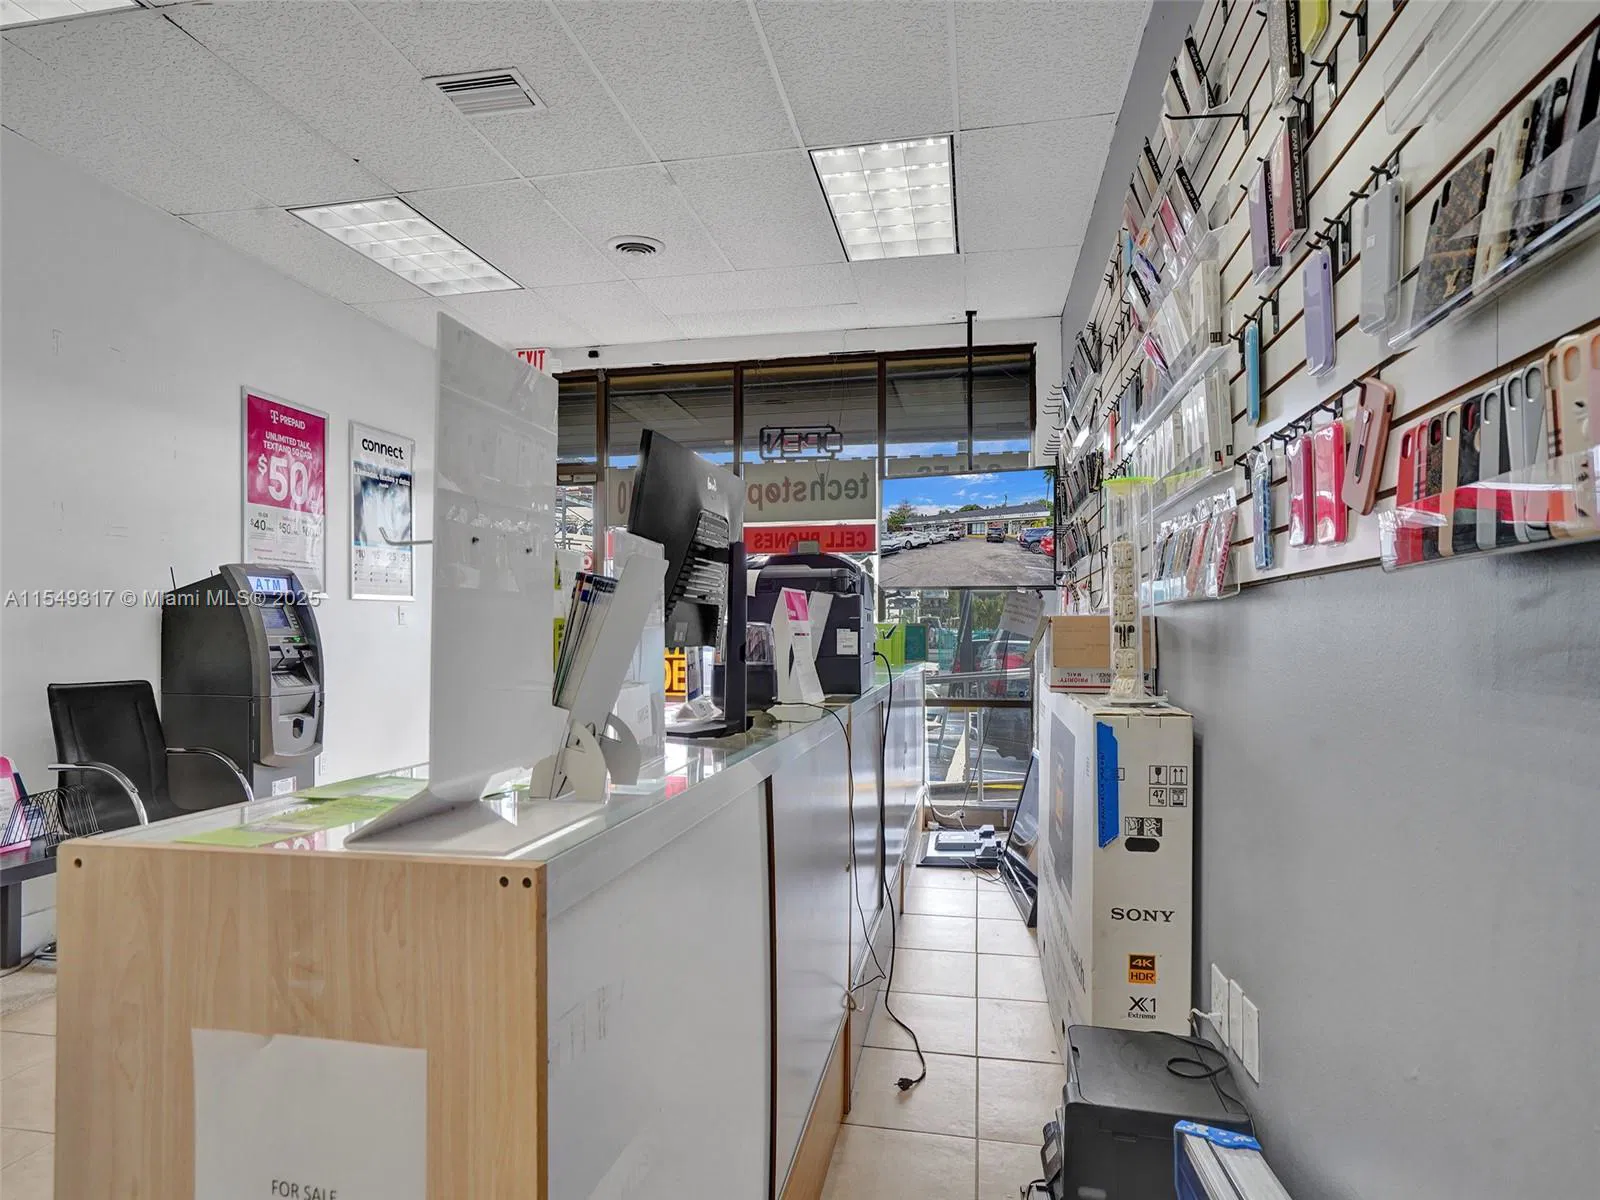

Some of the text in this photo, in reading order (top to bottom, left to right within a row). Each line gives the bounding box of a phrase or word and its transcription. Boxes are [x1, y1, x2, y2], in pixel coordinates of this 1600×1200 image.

[280, 414, 306, 430] PREPAID
[265, 431, 297, 447] UNLIMITED
[263, 440, 279, 452] TEXT
[279, 445, 292, 455] AND
[361, 438, 404, 460] connect
[257, 454, 308, 505] $50
[250, 518, 266, 531] $40
[255, 578, 282, 591] ATM
[1152, 790, 1164, 798] 47
[1111, 907, 1175, 922] SONY
[1131, 959, 1153, 968] 4K
[1130, 971, 1155, 981] HDR
[271, 1179, 300, 1199] FOR
